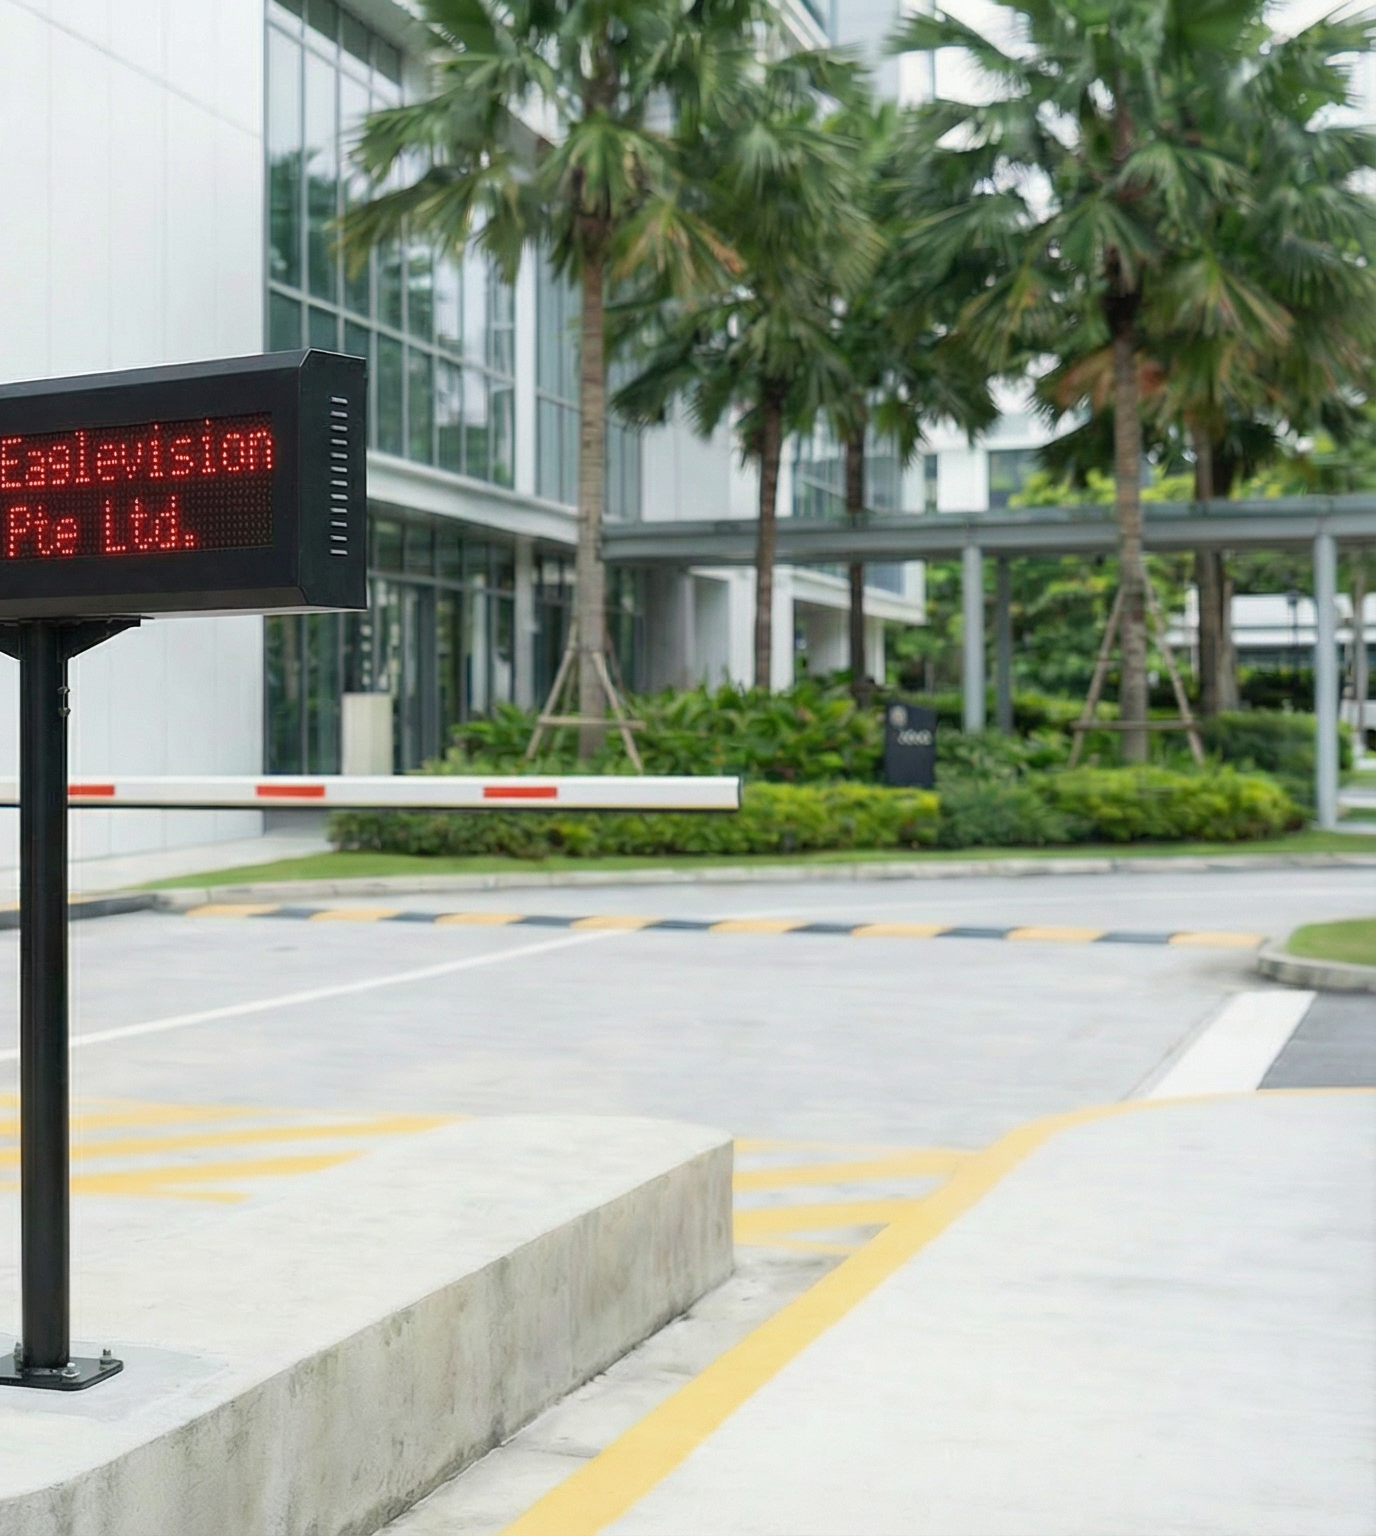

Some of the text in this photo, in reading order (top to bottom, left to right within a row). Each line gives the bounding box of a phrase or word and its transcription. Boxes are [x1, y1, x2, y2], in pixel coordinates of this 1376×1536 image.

[0, 417, 274, 489] Eaglevision
[9, 504, 78, 558] Pte
[105, 494, 195, 553] Ltd.
